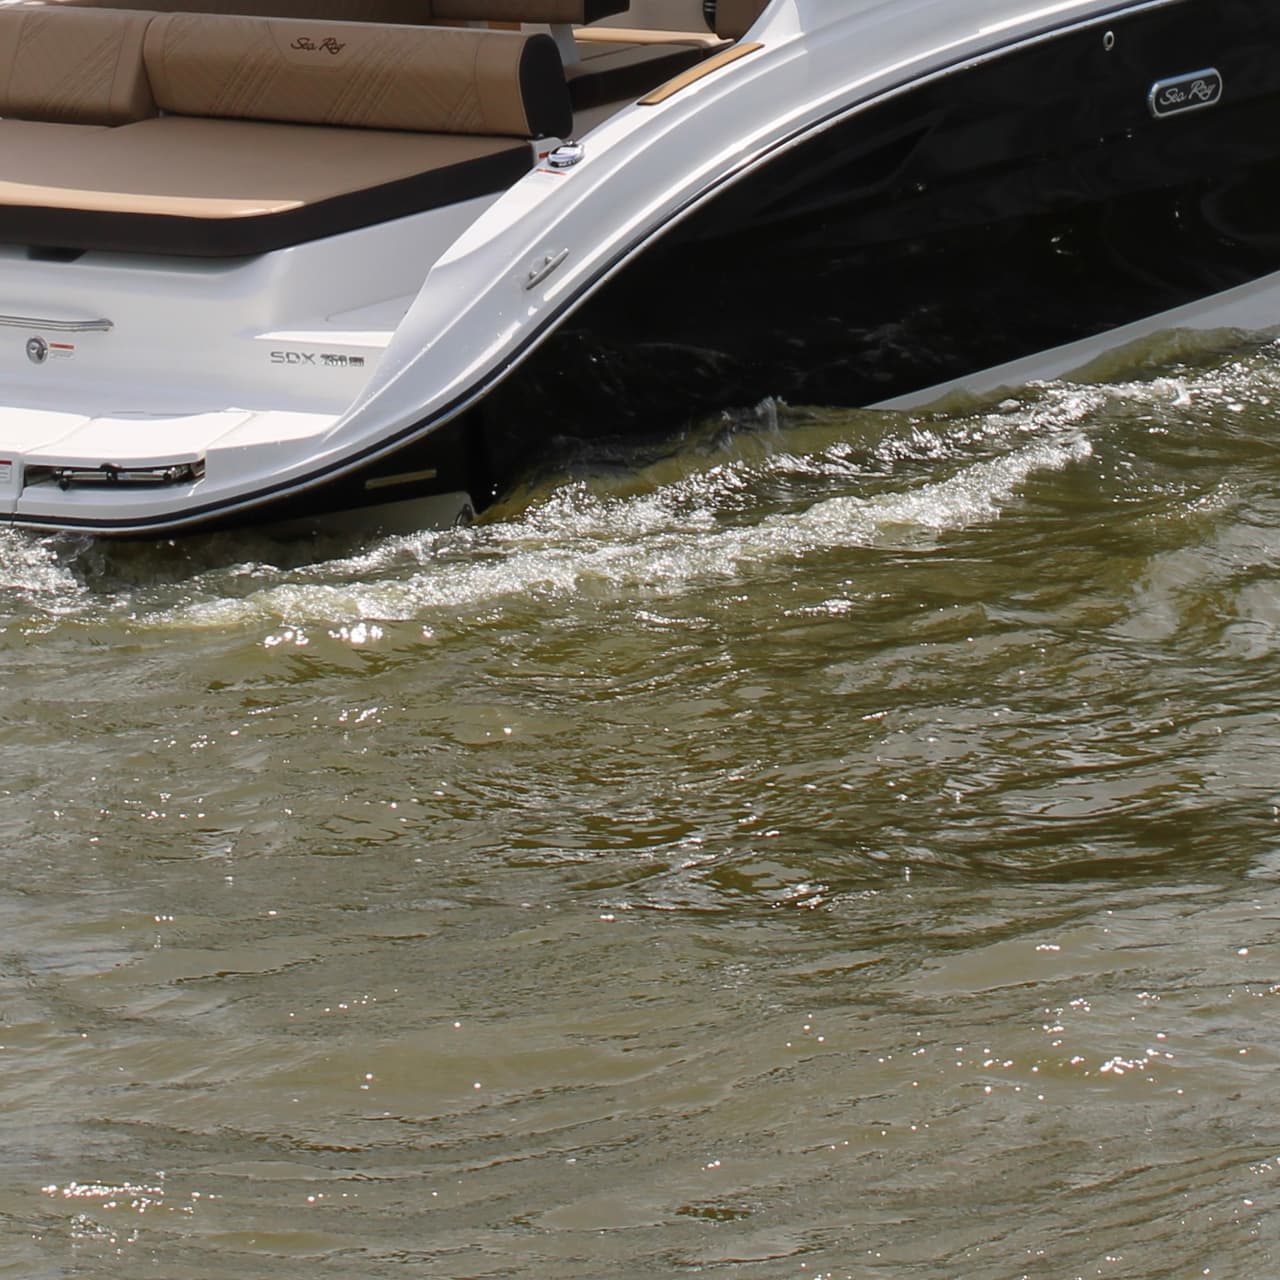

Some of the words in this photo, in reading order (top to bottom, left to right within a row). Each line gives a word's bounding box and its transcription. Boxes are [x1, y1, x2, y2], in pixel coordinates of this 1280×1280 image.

[290, 36, 317, 51] Sea
[318, 36, 346, 55] Ray
[1159, 87, 1187, 105] Sea
[1188, 79, 1217, 101] Ray
[270, 350, 317, 366] SDX
